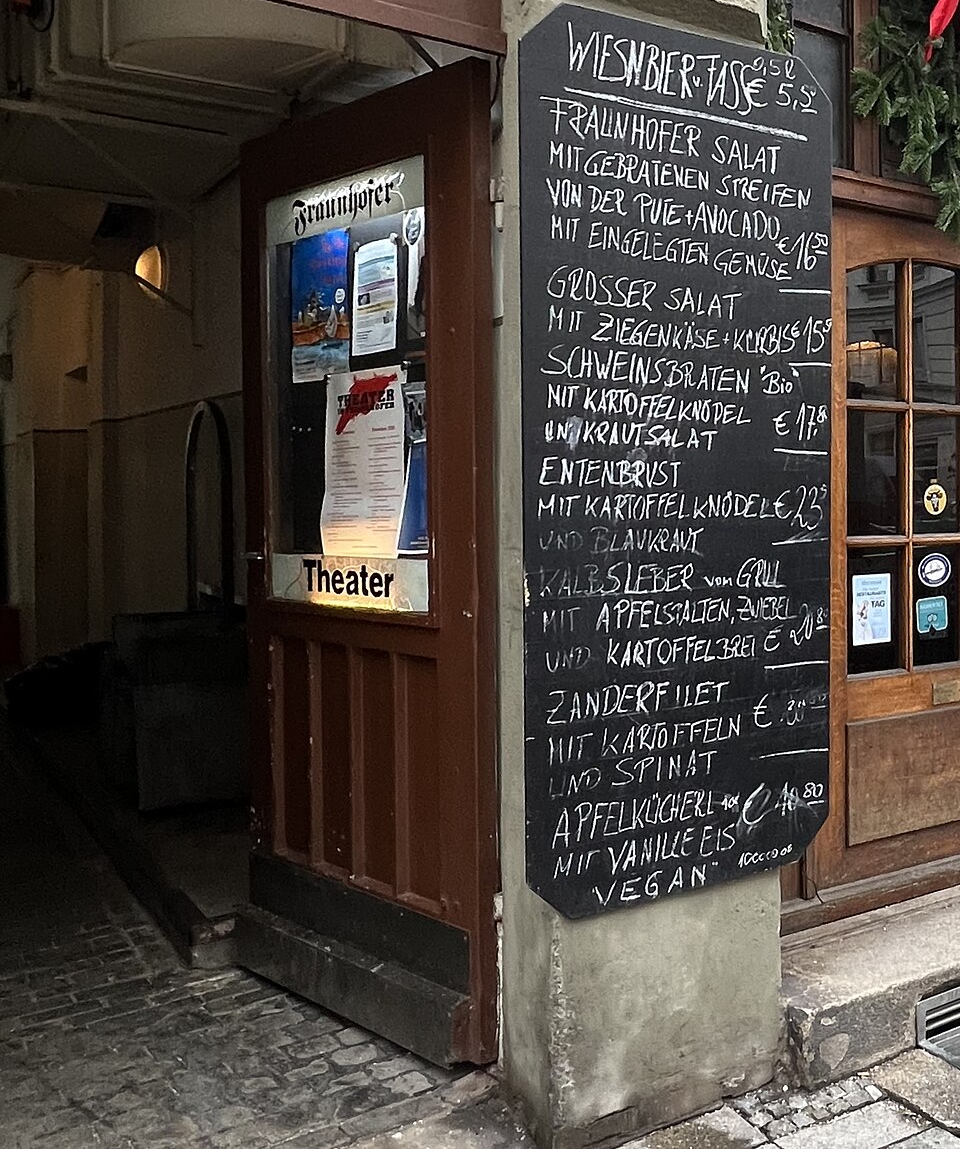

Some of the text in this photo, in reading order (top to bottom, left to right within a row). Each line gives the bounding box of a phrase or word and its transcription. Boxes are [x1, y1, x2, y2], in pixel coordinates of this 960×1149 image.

[567, 22, 695, 98] WIESNBIER
[541, 96, 781, 174] FRAUNHOFER SALAT
[549, 142, 812, 208] MIT GEBRATENEN STREIFEN
[292, 179, 395, 237] Fraunhofer
[546, 178, 582, 208] VON
[588, 185, 627, 216] DER
[551, 214, 579, 242] MIT
[588, 222, 709, 265] EINGELEGTEN
[714, 249, 792, 281] GEMÜSE
[547, 265, 742, 320] GROSSER SALAT
[549, 305, 585, 332] MIT
[590, 313, 720, 349] ZIEGENKÄSE
[541, 344, 750, 394] SCHWEINSBRATEN
[583, 421, 718, 451] KRAUTSALAT
[538, 456, 681, 488] ENTENBRUST
[537, 494, 581, 520] MIT
[539, 526, 704, 555] UND BLAUKRAUT
[303, 559, 394, 598] Theater
[737, 558, 787, 588] GRILL
[542, 607, 581, 633] MIT
[870, 600, 885, 608] TAG
[545, 647, 591, 672] UND
[546, 681, 730, 725] ZANDERFILET
[602, 714, 742, 756] KARTOFFELN
[549, 750, 718, 799] UND SPINAT
[553, 850, 600, 879] MIT
